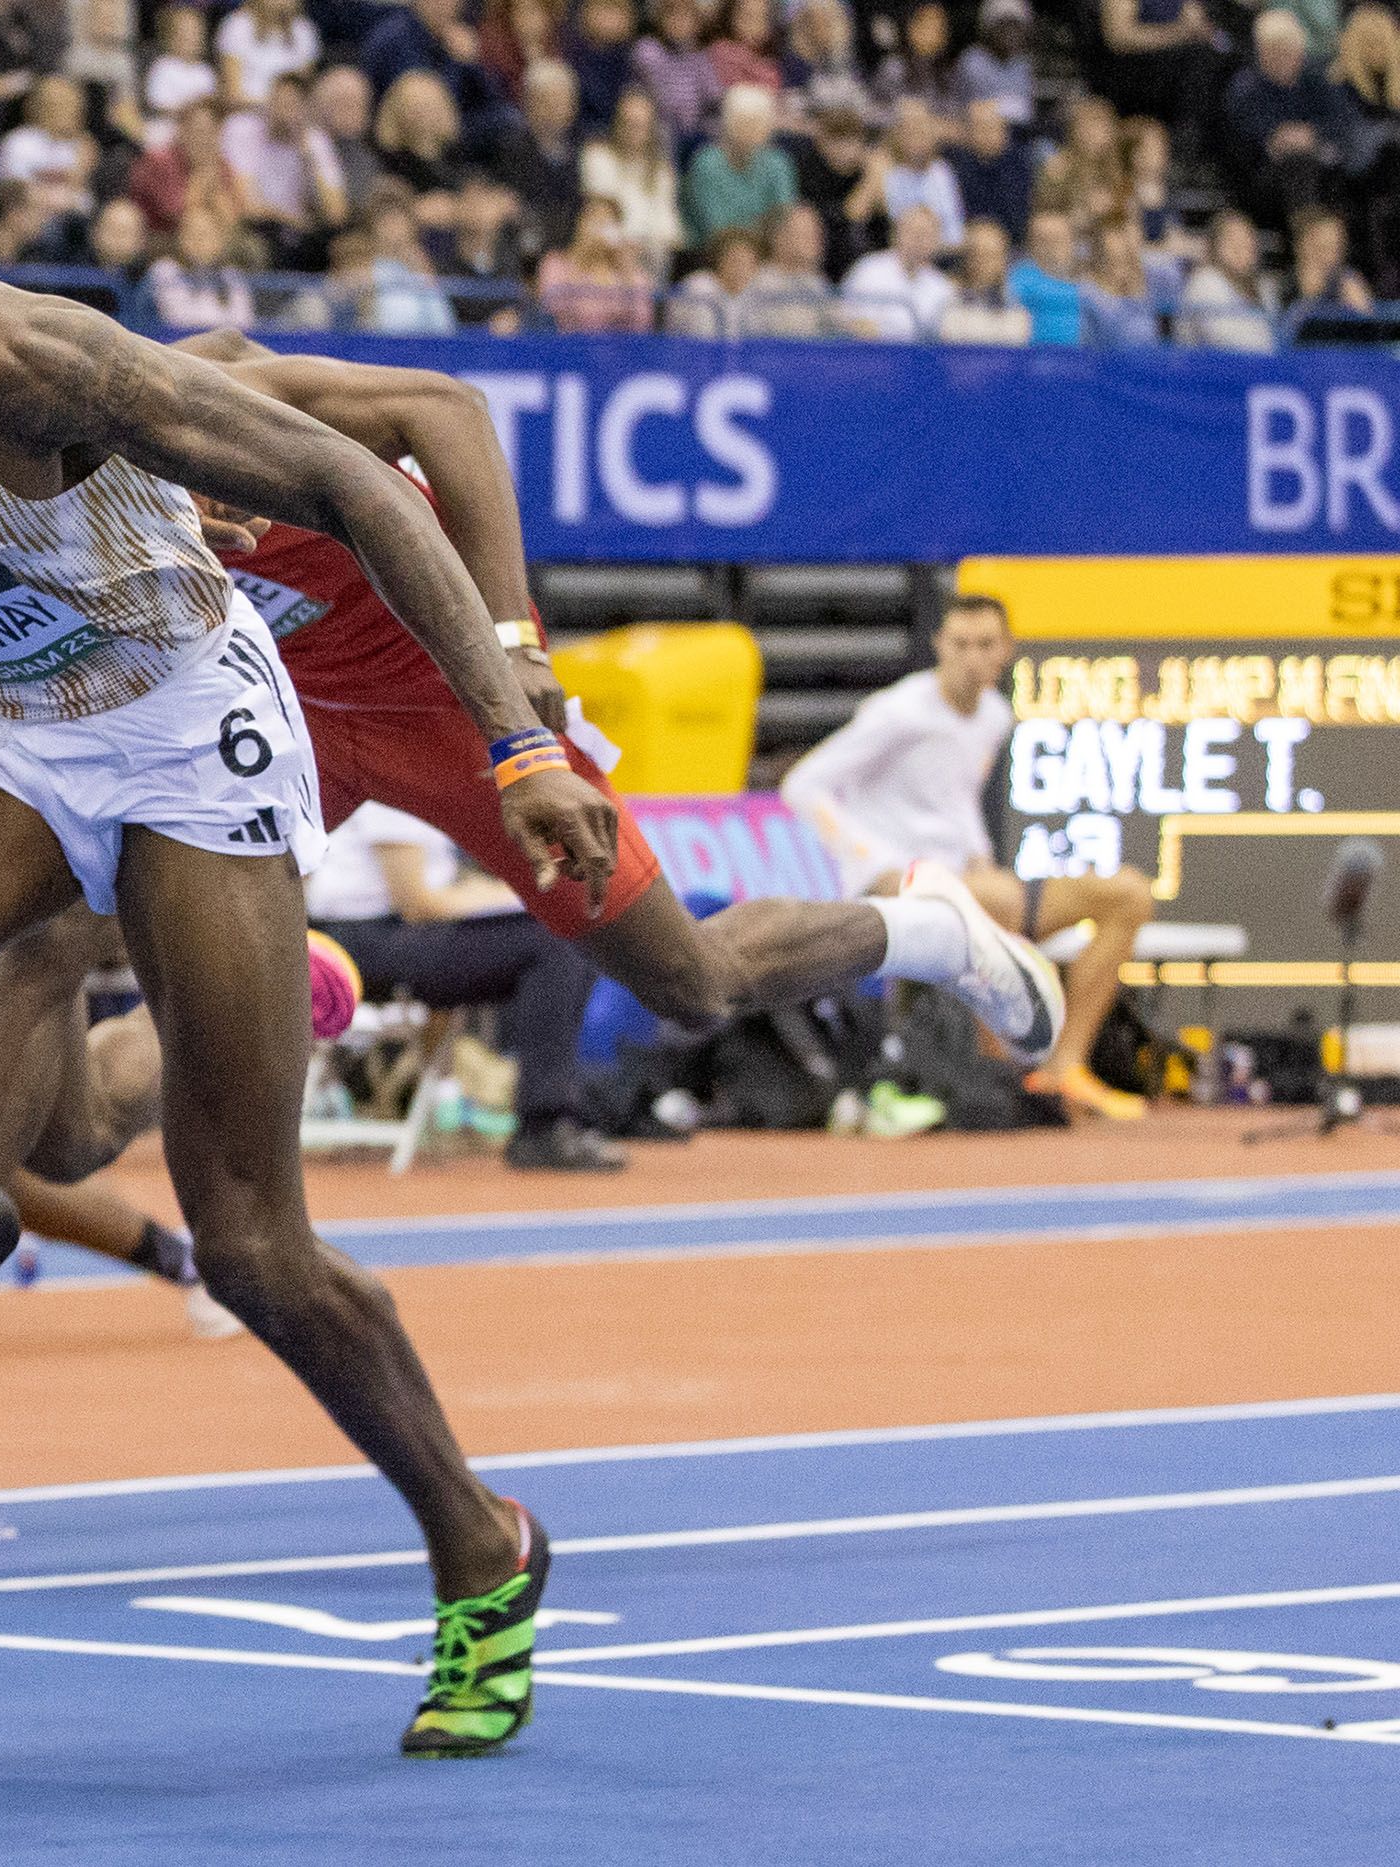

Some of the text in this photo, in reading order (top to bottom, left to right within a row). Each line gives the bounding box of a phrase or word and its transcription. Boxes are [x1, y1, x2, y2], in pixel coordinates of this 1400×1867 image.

[1247, 386, 1400, 533] BR
[1330, 572, 1400, 626] S
[60, 630, 96, 654] 23
[218, 707, 274, 778] 6
[1010, 717, 1326, 814] GAYLE T.
